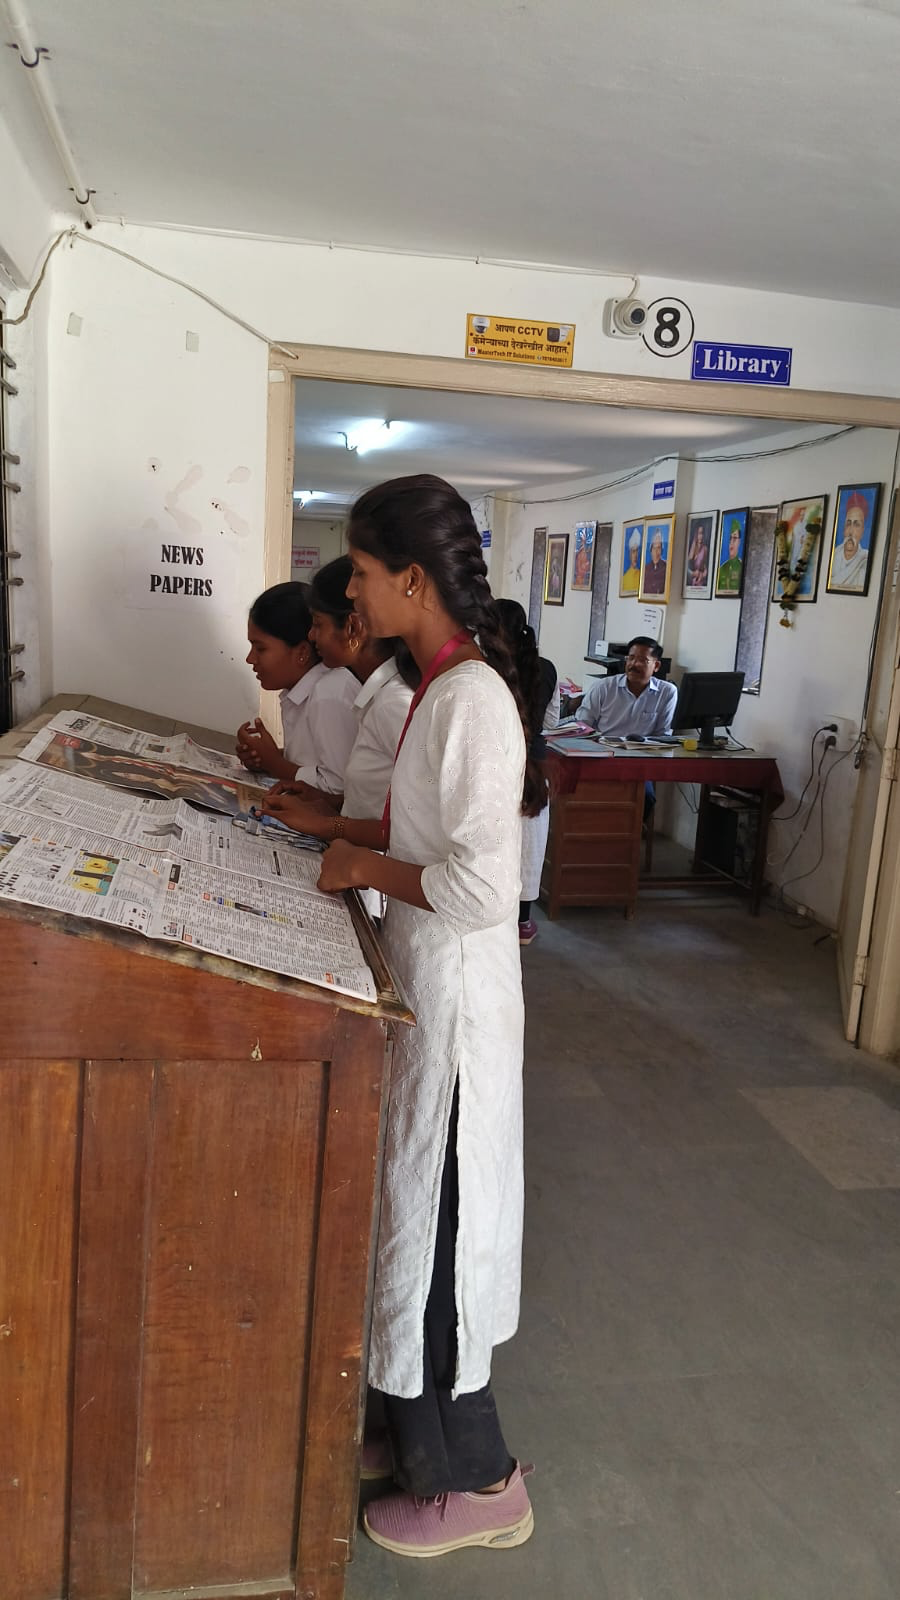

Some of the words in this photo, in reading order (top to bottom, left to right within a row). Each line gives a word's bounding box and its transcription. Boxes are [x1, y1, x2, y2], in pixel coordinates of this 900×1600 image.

[495, 323, 516, 334] आपण
[517, 327, 544, 337] CCTV
[654, 307, 681, 348] 8
[702, 348, 782, 378] Library
[161, 544, 204, 566] NEWS
[150, 574, 213, 597] PAPERS
